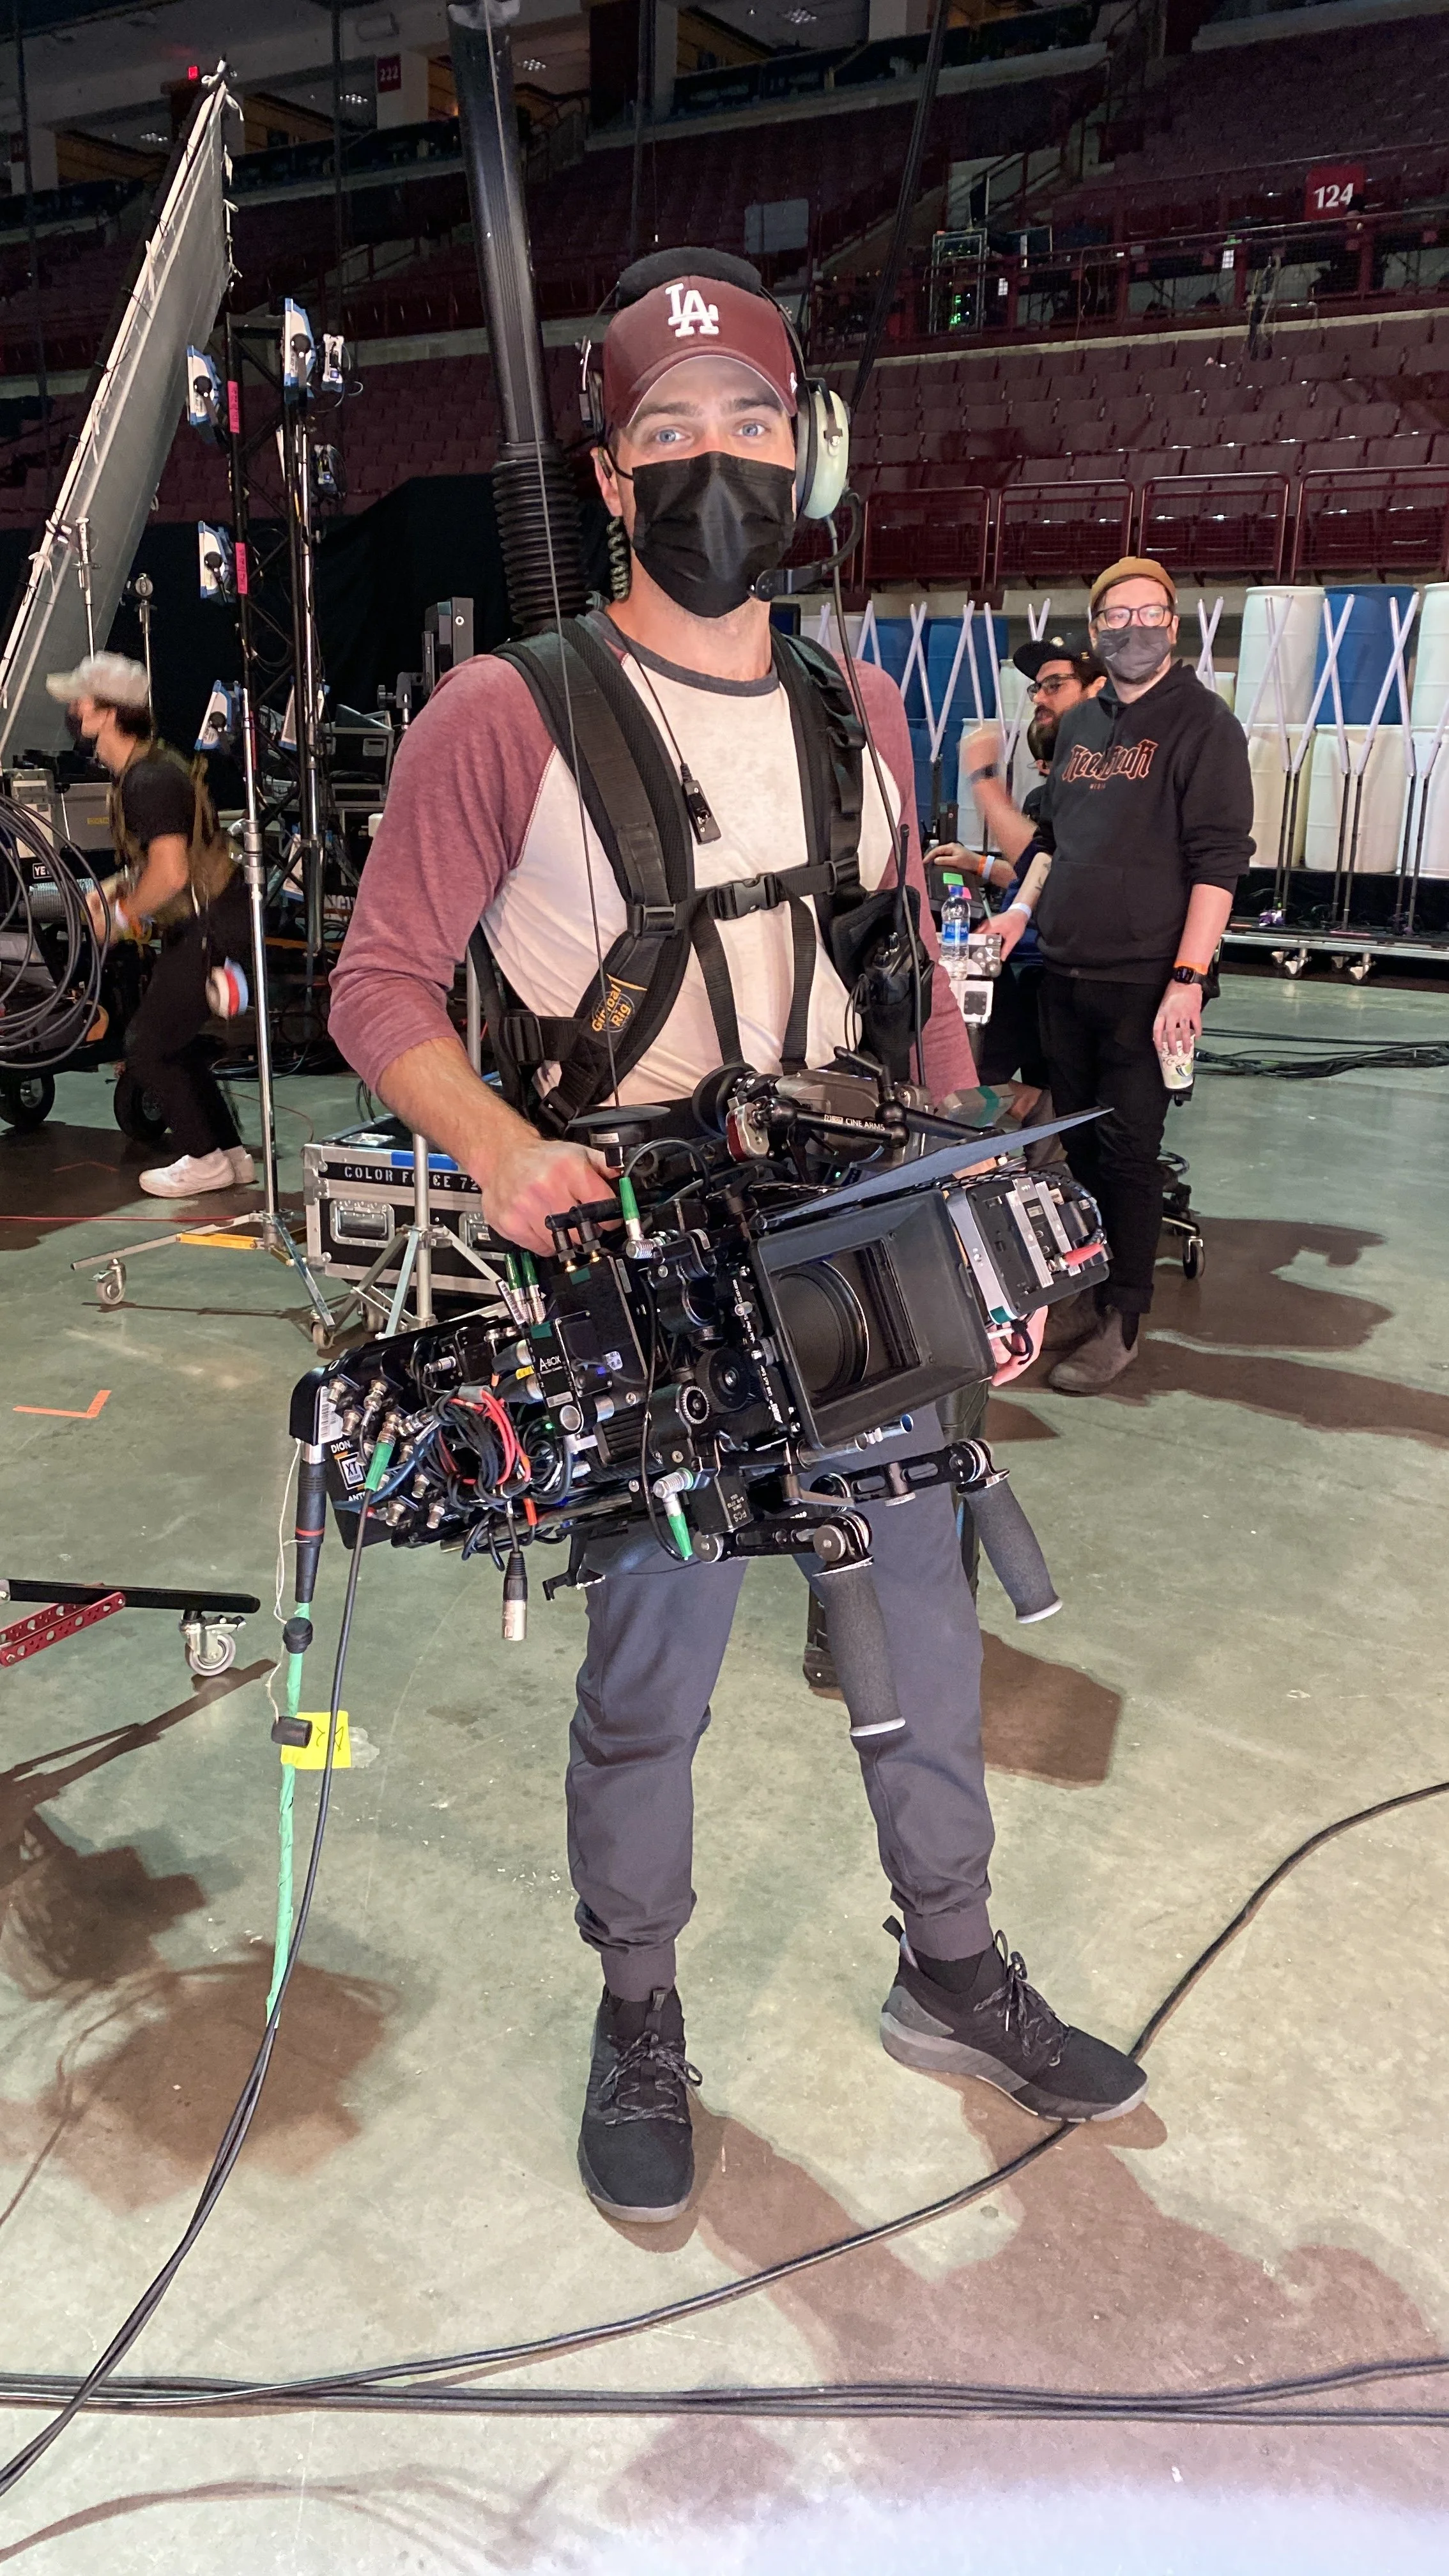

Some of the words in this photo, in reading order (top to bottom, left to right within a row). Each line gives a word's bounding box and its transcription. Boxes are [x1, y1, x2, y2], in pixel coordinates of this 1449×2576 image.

[379, 65, 399, 81] 222
[1314, 183, 1354, 209] 124
[665, 282, 719, 337] LA
[34, 866, 50, 875] YE
[610, 1004, 631, 1027] Rig
[845, 1117, 862, 1128] CINE
[864, 1121, 885, 1131] ARMS
[344, 1166, 393, 1182] COLOR
[402, 1171, 451, 1188] FCE
[330, 1439, 353, 1454] DION
[344, 1460, 358, 1476] XT
